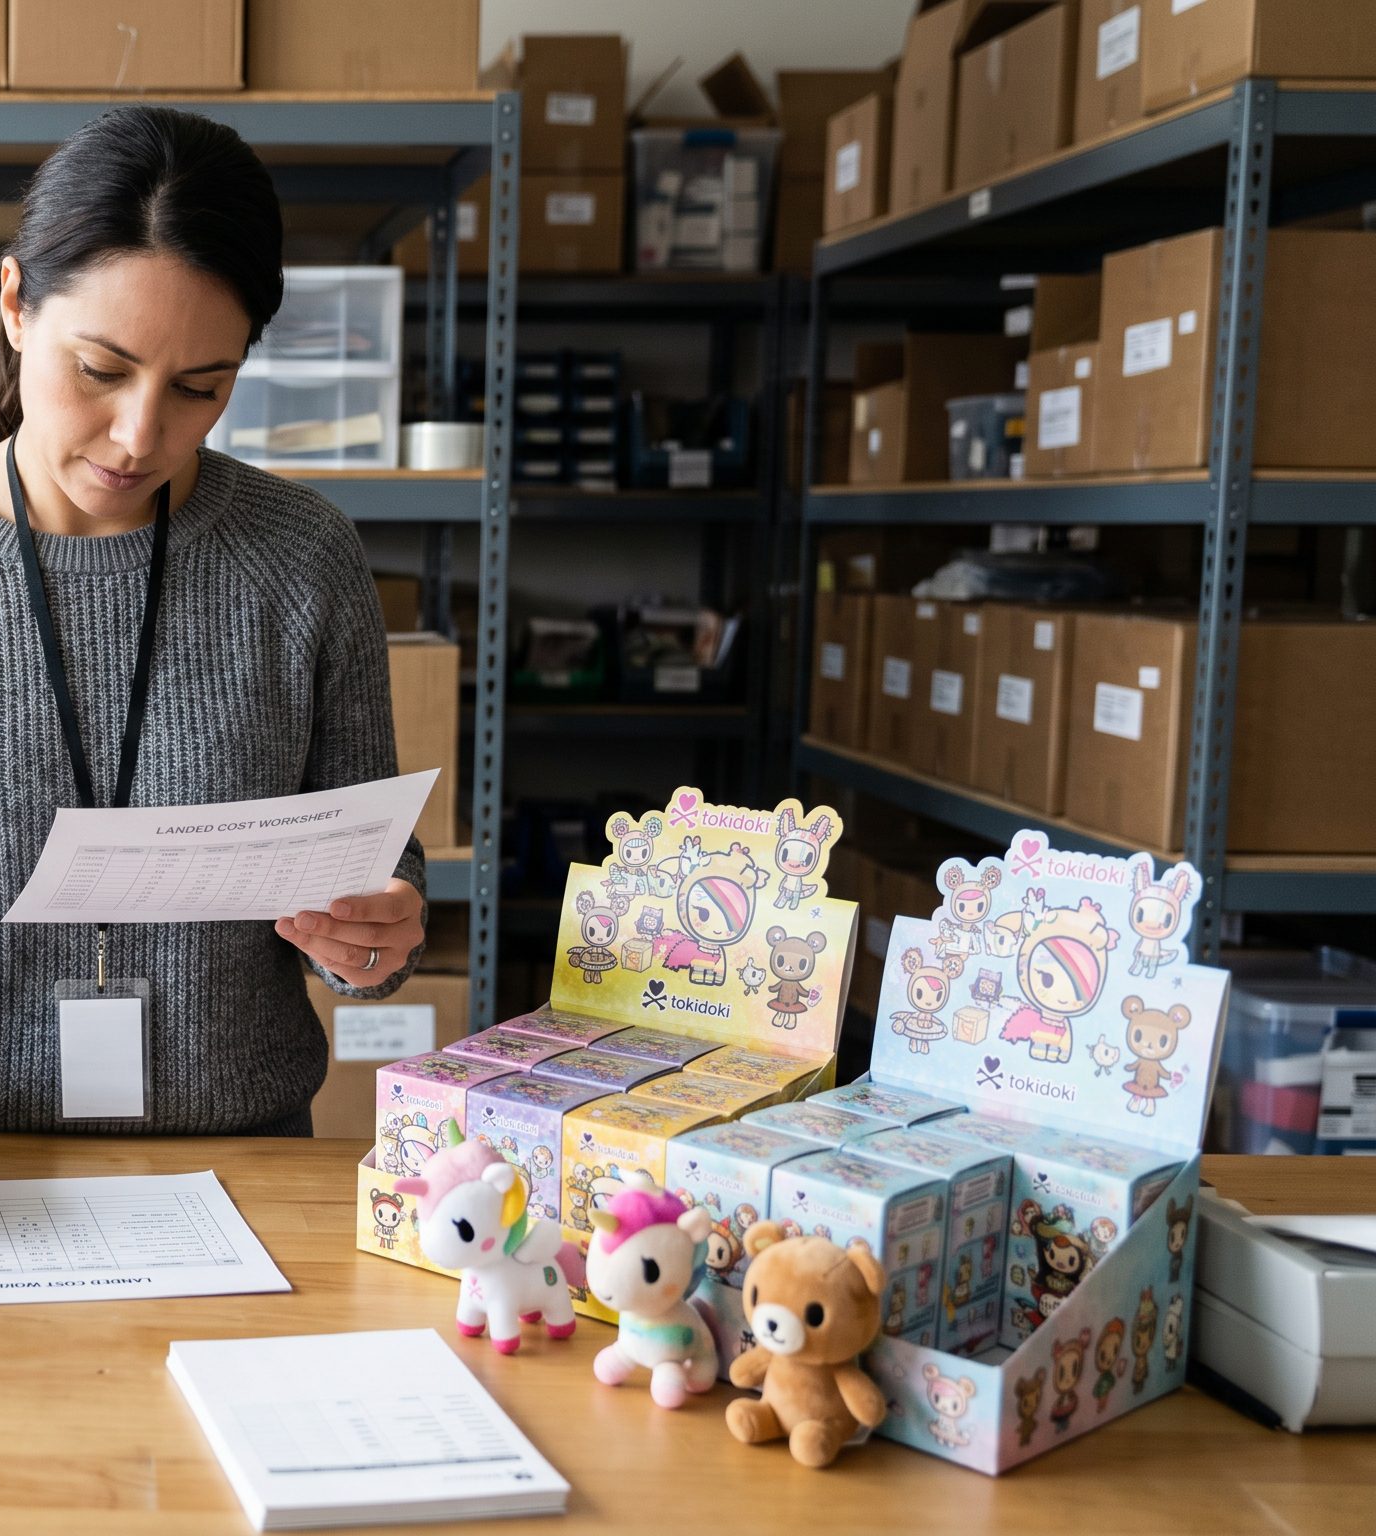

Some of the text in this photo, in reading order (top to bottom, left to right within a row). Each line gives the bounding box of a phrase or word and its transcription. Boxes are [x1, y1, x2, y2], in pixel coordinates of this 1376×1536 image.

[156, 809, 344, 835] LANDED COST WORKSHEET
[702, 810, 771, 833] tokidoki
[1047, 858, 1126, 884] tokidoki
[670, 995, 731, 1018] tokidoki
[1009, 1074, 1076, 1101] tokidoki
[90, 1277, 152, 1285] LANDED
